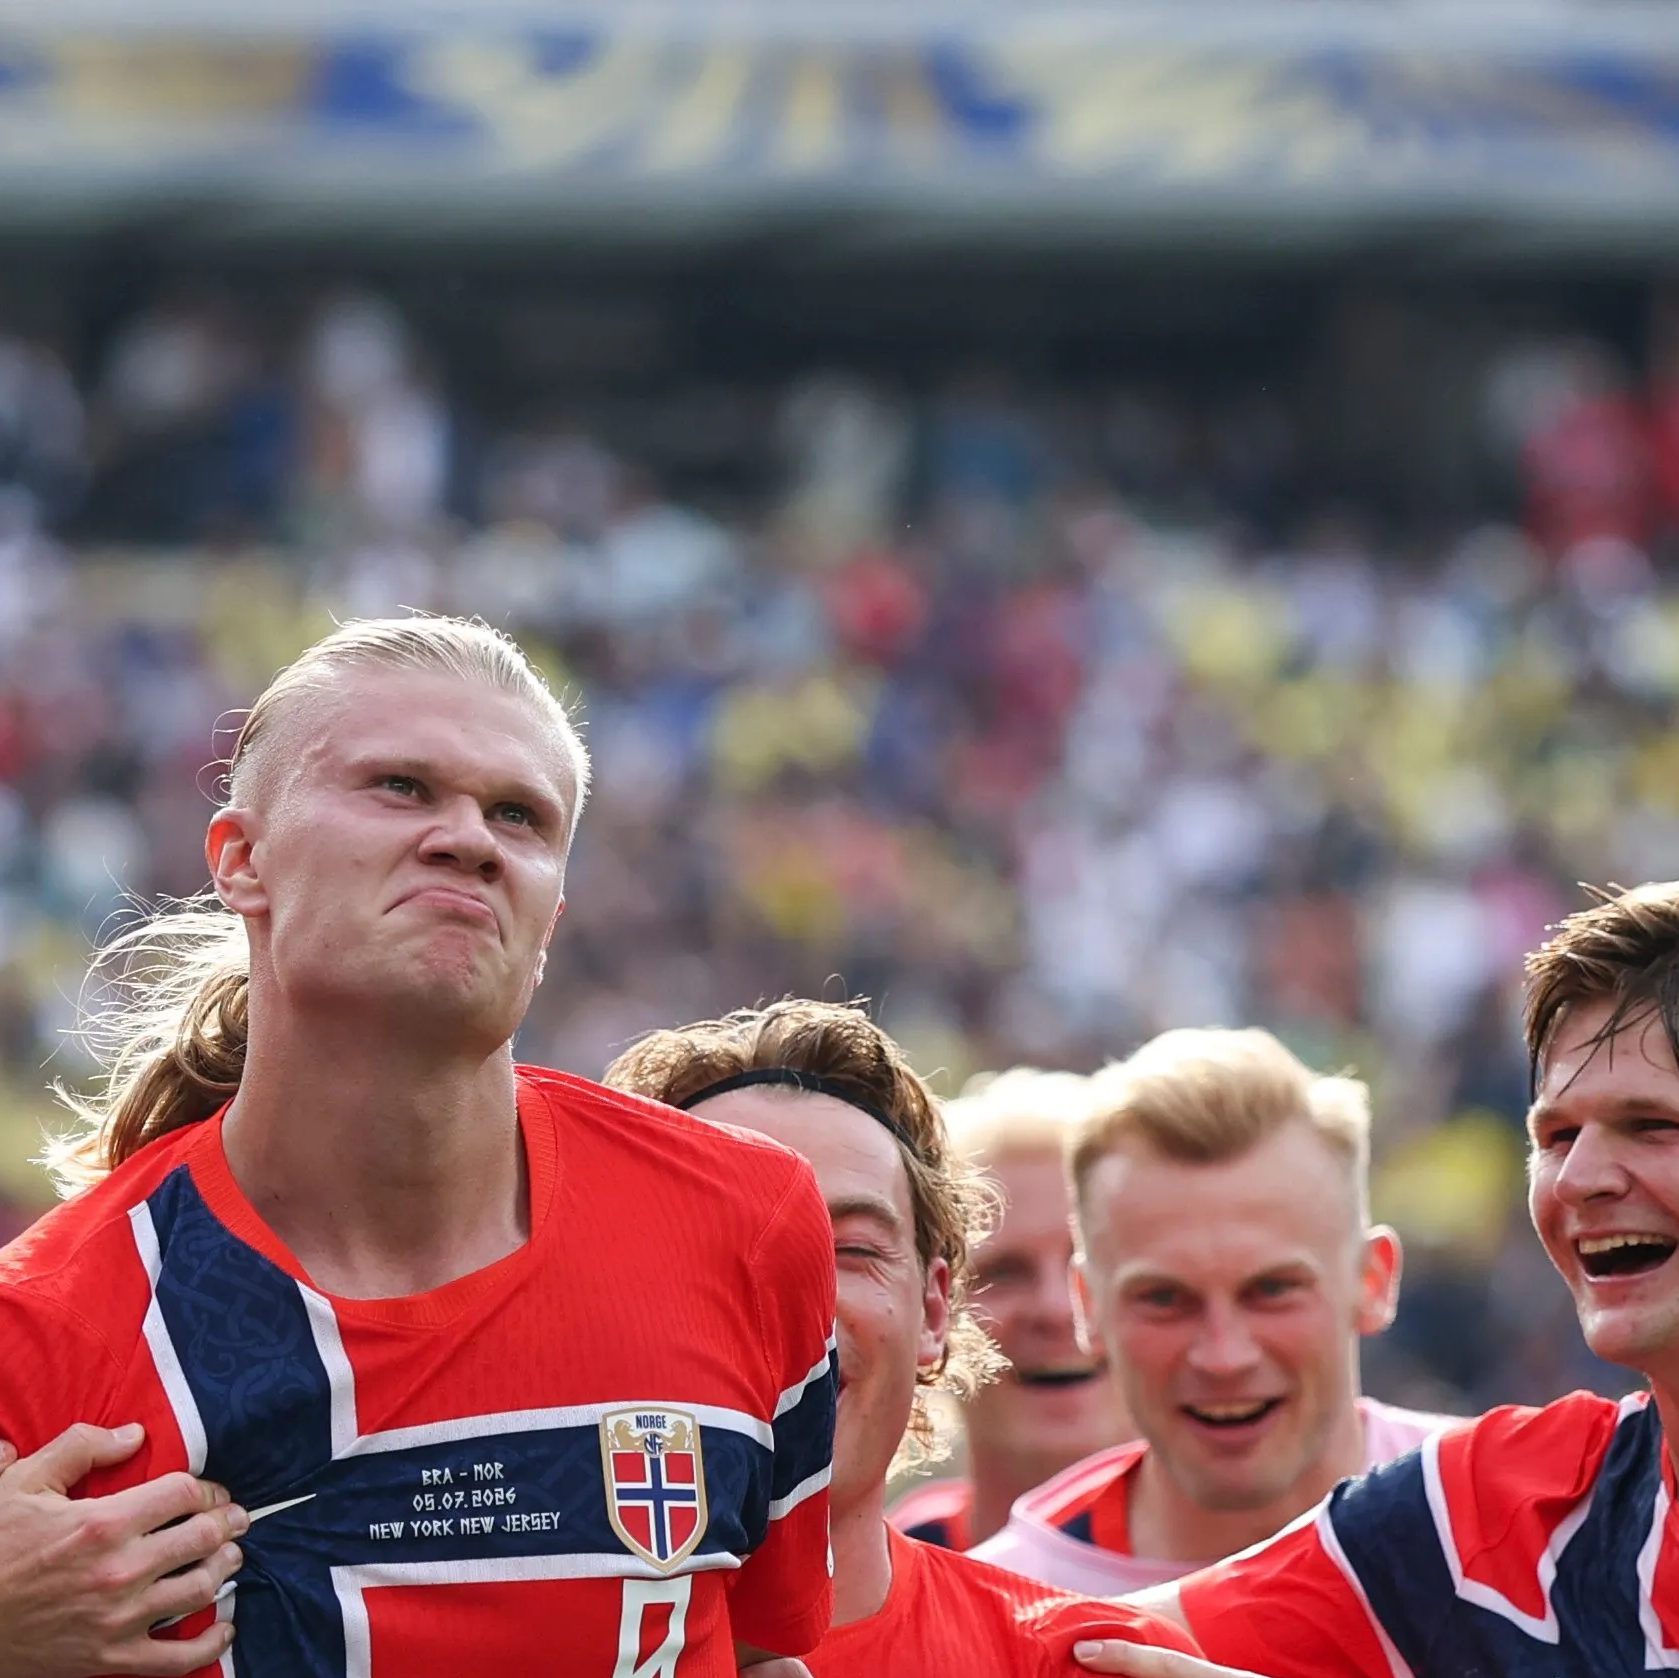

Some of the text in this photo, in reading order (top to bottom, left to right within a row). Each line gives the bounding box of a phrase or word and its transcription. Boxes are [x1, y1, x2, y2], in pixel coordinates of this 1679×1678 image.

[635, 1415, 668, 1429] NORGE
[422, 1467, 453, 1486] BRA
[473, 1462, 504, 1481] NOR
[413, 1487, 516, 1512] 05.07.2026
[369, 1511, 561, 1540] NEW YORK NEW JERSEY
